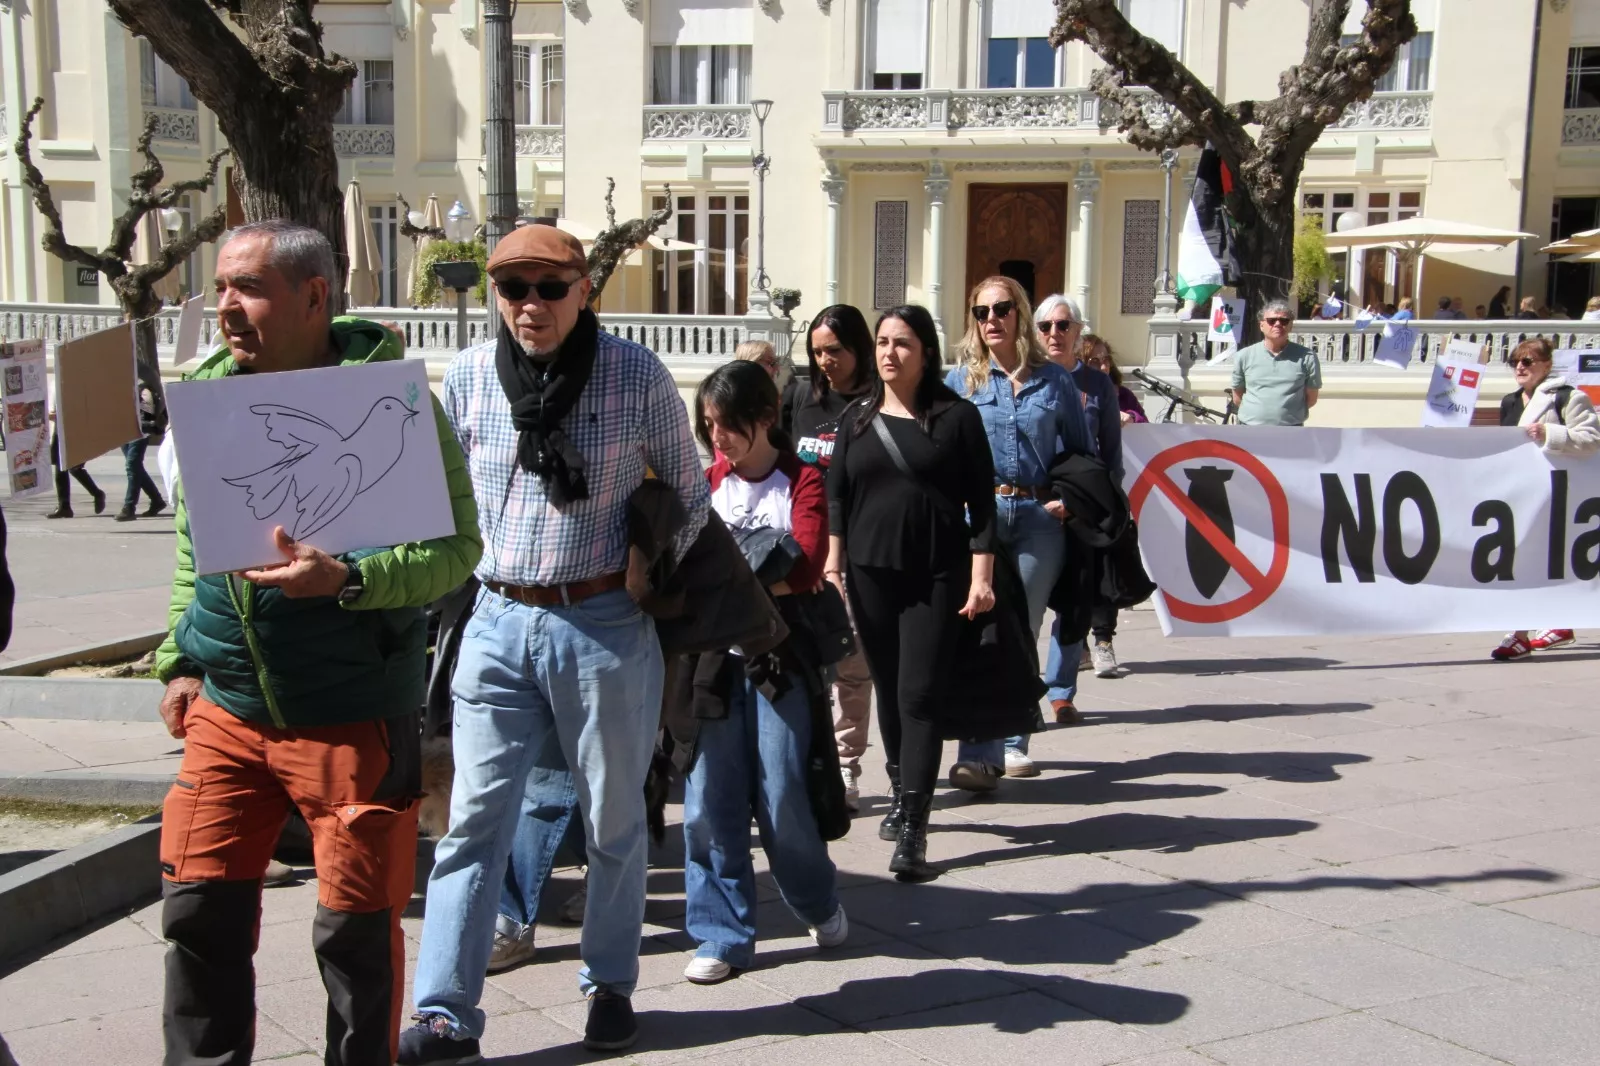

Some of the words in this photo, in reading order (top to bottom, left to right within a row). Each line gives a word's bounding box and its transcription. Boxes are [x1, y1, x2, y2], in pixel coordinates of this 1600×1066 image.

[80, 270, 98, 282] flor
[1320, 470, 1441, 585] NO
[1471, 499, 1515, 583] a
[1548, 469, 1600, 581] la
